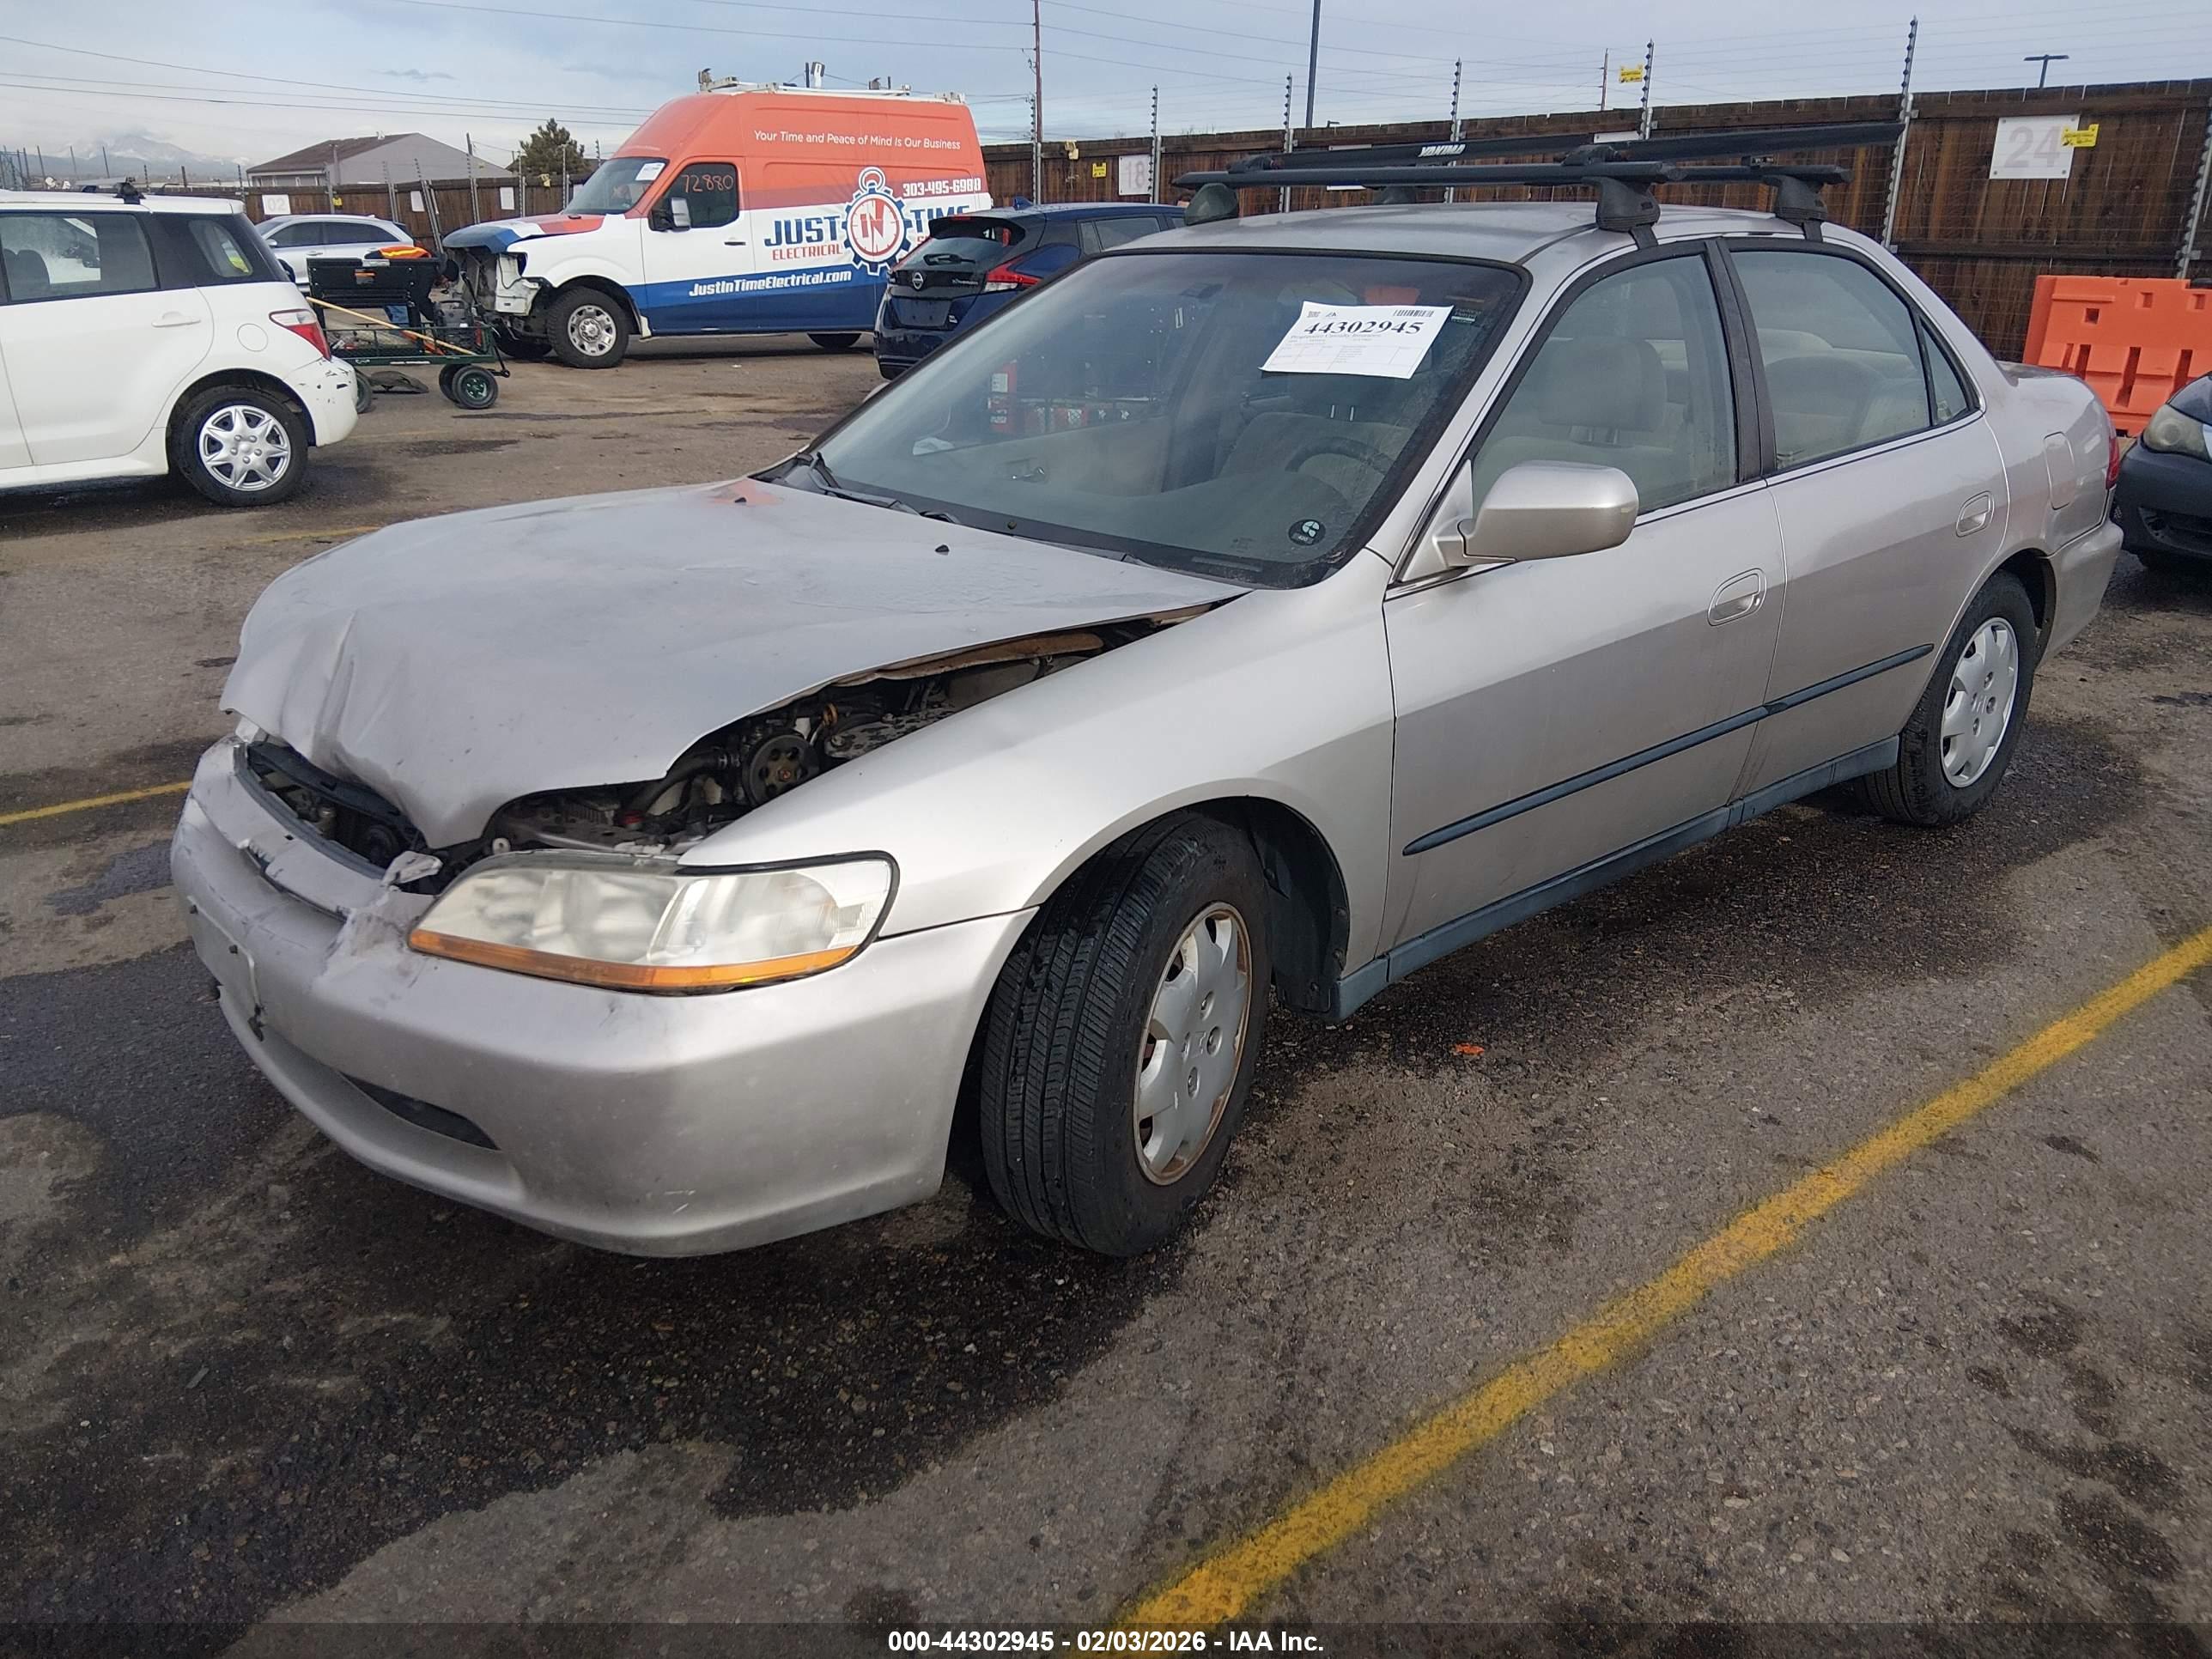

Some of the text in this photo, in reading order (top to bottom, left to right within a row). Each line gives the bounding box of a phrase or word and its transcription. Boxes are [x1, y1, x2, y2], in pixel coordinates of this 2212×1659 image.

[754, 130, 961, 149] Your Time and Peace of Mind Is Our Business
[2004, 125, 2061, 168] 24
[1418, 143, 1467, 158] YAKIMA
[681, 174, 734, 193] 72880
[764, 215, 841, 246] JUST
[772, 244, 843, 260] ELECTRICAL
[689, 270, 852, 297] JustInTimeElectrical.com
[1304, 320, 1424, 335] 44302945
